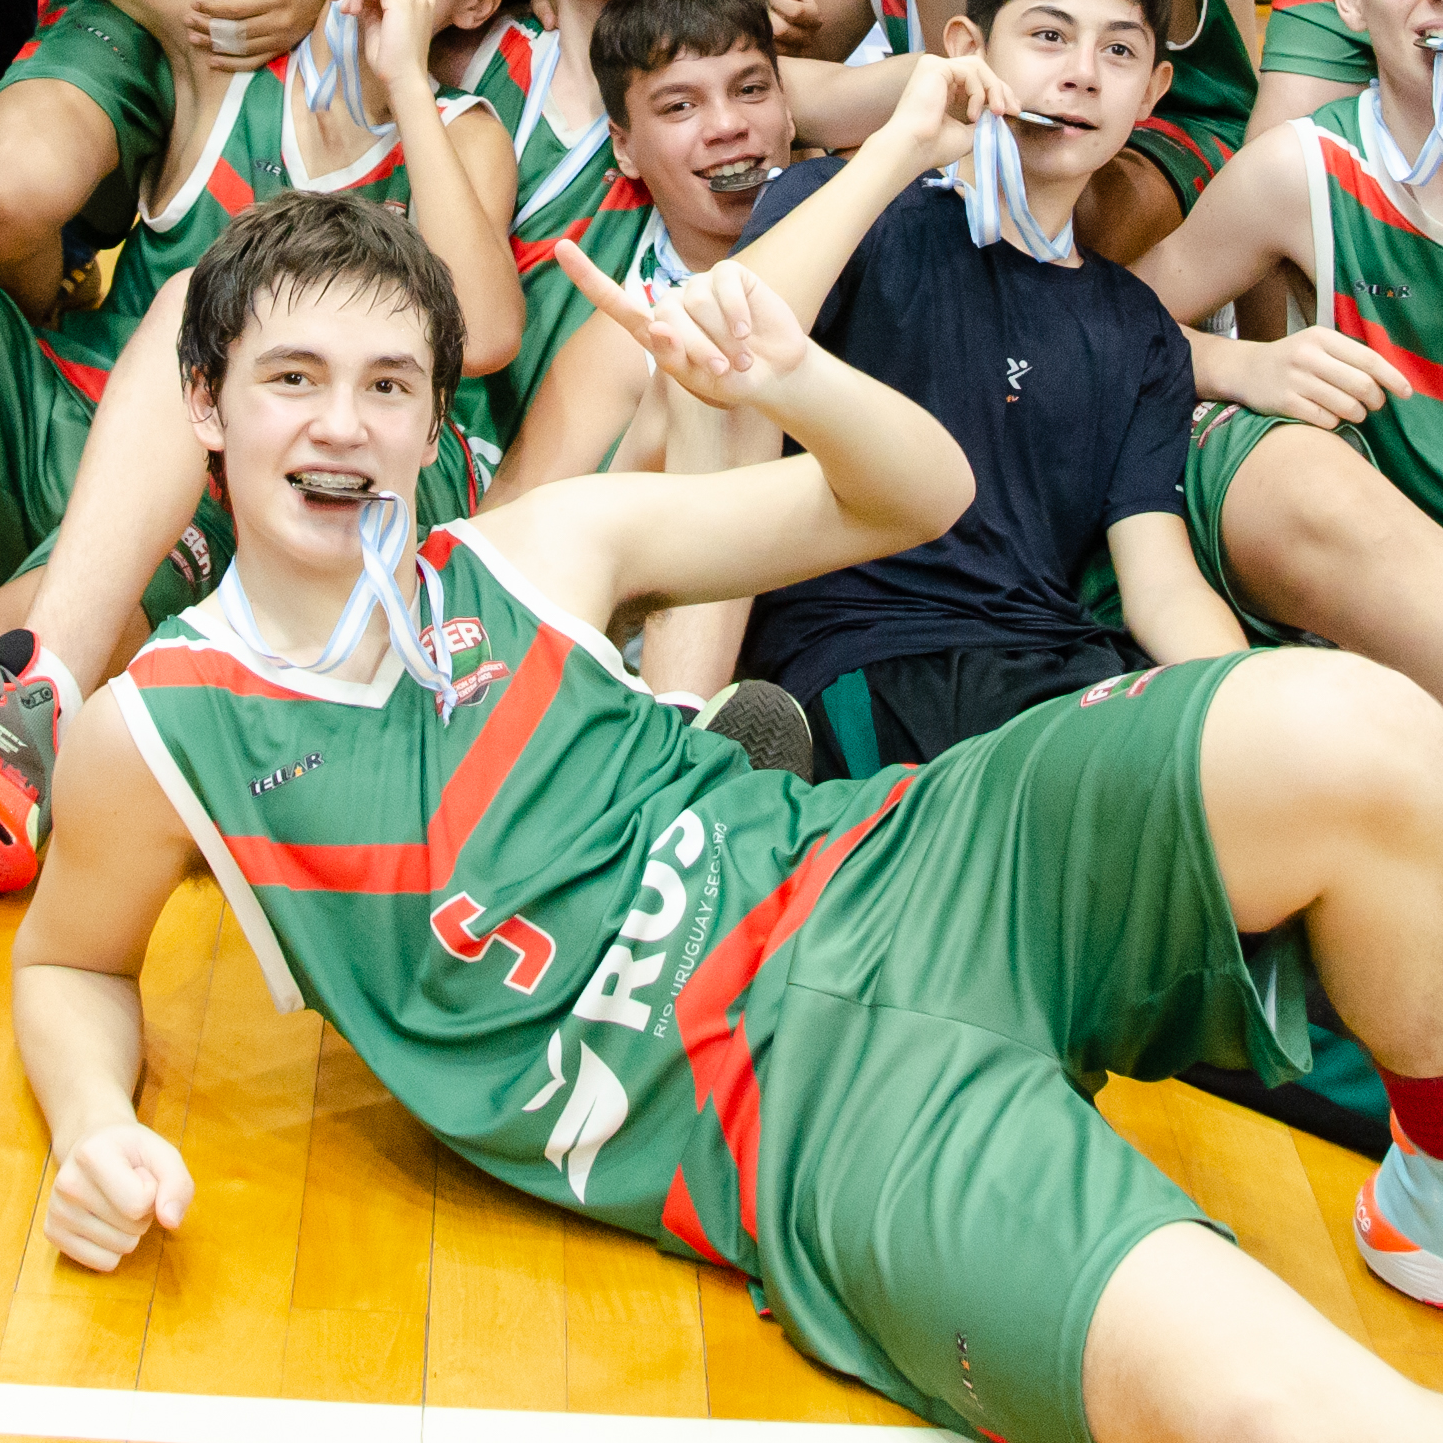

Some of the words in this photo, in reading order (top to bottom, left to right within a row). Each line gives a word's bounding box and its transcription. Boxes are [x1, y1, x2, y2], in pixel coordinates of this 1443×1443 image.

[429, 890, 557, 996] 5
[572, 808, 706, 1033] RUS
[652, 1002, 674, 1040] RIO
[669, 898, 715, 999] URUGUAY
